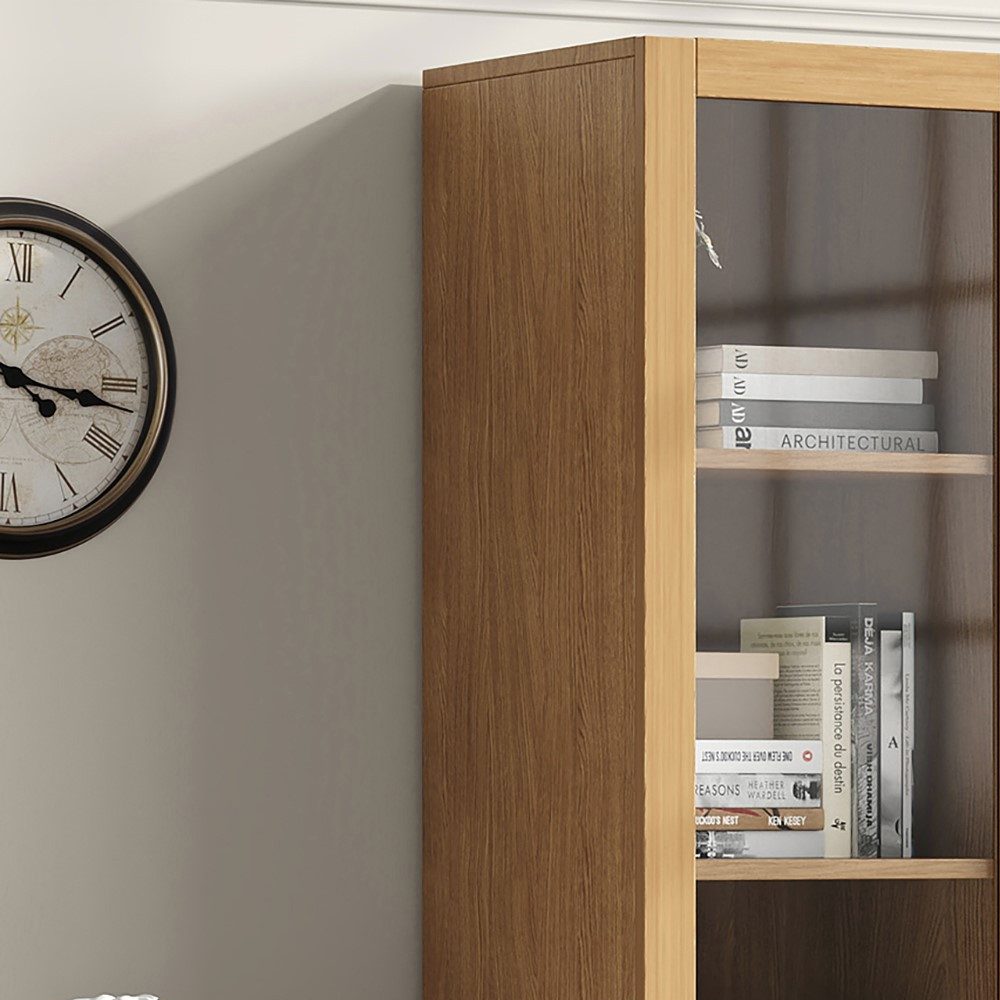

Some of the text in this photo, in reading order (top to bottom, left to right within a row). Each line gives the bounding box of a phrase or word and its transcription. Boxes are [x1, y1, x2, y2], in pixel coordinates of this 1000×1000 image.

[781, 433, 925, 452] ARCHITECTURAL
[864, 661, 874, 716] KARMA
[831, 662, 846, 794] La persistance du destin
[748, 780, 785, 790] HEATHER
[747, 790, 786, 800] WARDELL
[768, 815, 807, 826] KEN KESEY
